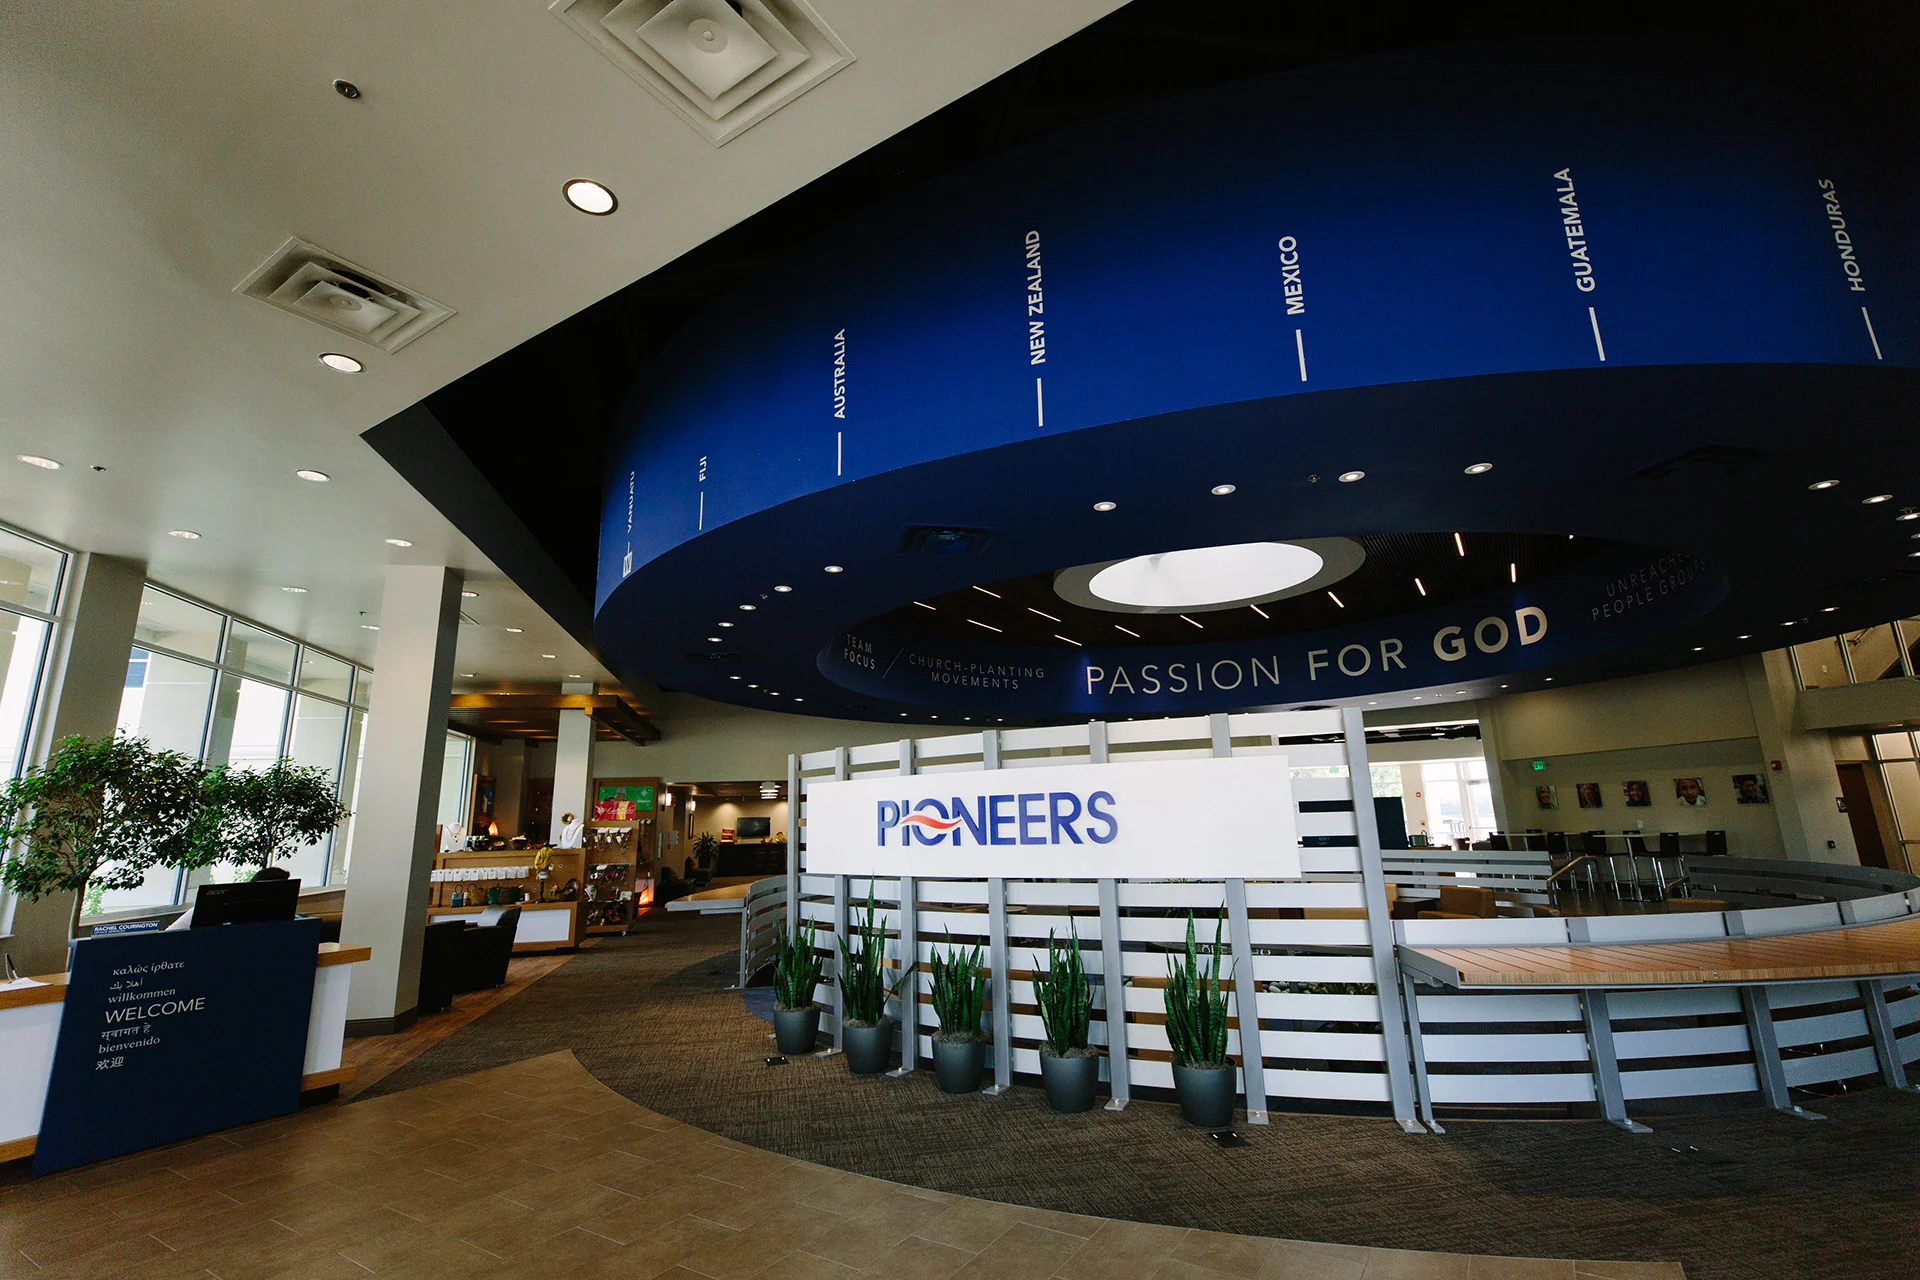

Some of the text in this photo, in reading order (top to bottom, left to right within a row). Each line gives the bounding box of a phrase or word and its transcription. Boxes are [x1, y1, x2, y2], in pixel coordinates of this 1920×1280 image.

[1553, 167, 1596, 292] GUATEMALA
[1818, 177, 1865, 291] HONDURAS
[1278, 235, 1305, 315] MEXICO
[1025, 230, 1046, 366] NEW ZEALAND
[834, 328, 846, 419] AUSTRALIA
[699, 456, 707, 482] FIJI
[627, 471, 635, 534] VANUATU
[1592, 586, 1654, 622] PEOPLE
[844, 648, 876, 670] FOCUS
[846, 633, 873, 654] TEAM
[1086, 606, 1548, 695] PASSION FOR GOD
[909, 653, 1045, 679] CHURCH-PLANTING
[931, 671, 1019, 690] MOVEMENTS
[877, 790, 1118, 846] PIONEERS
[104, 997, 206, 1024] WELCOME
[108, 987, 176, 1004] willkommen
[98, 1036, 160, 1054] bienvenido
[95, 1056, 124, 1070] 欢迎
